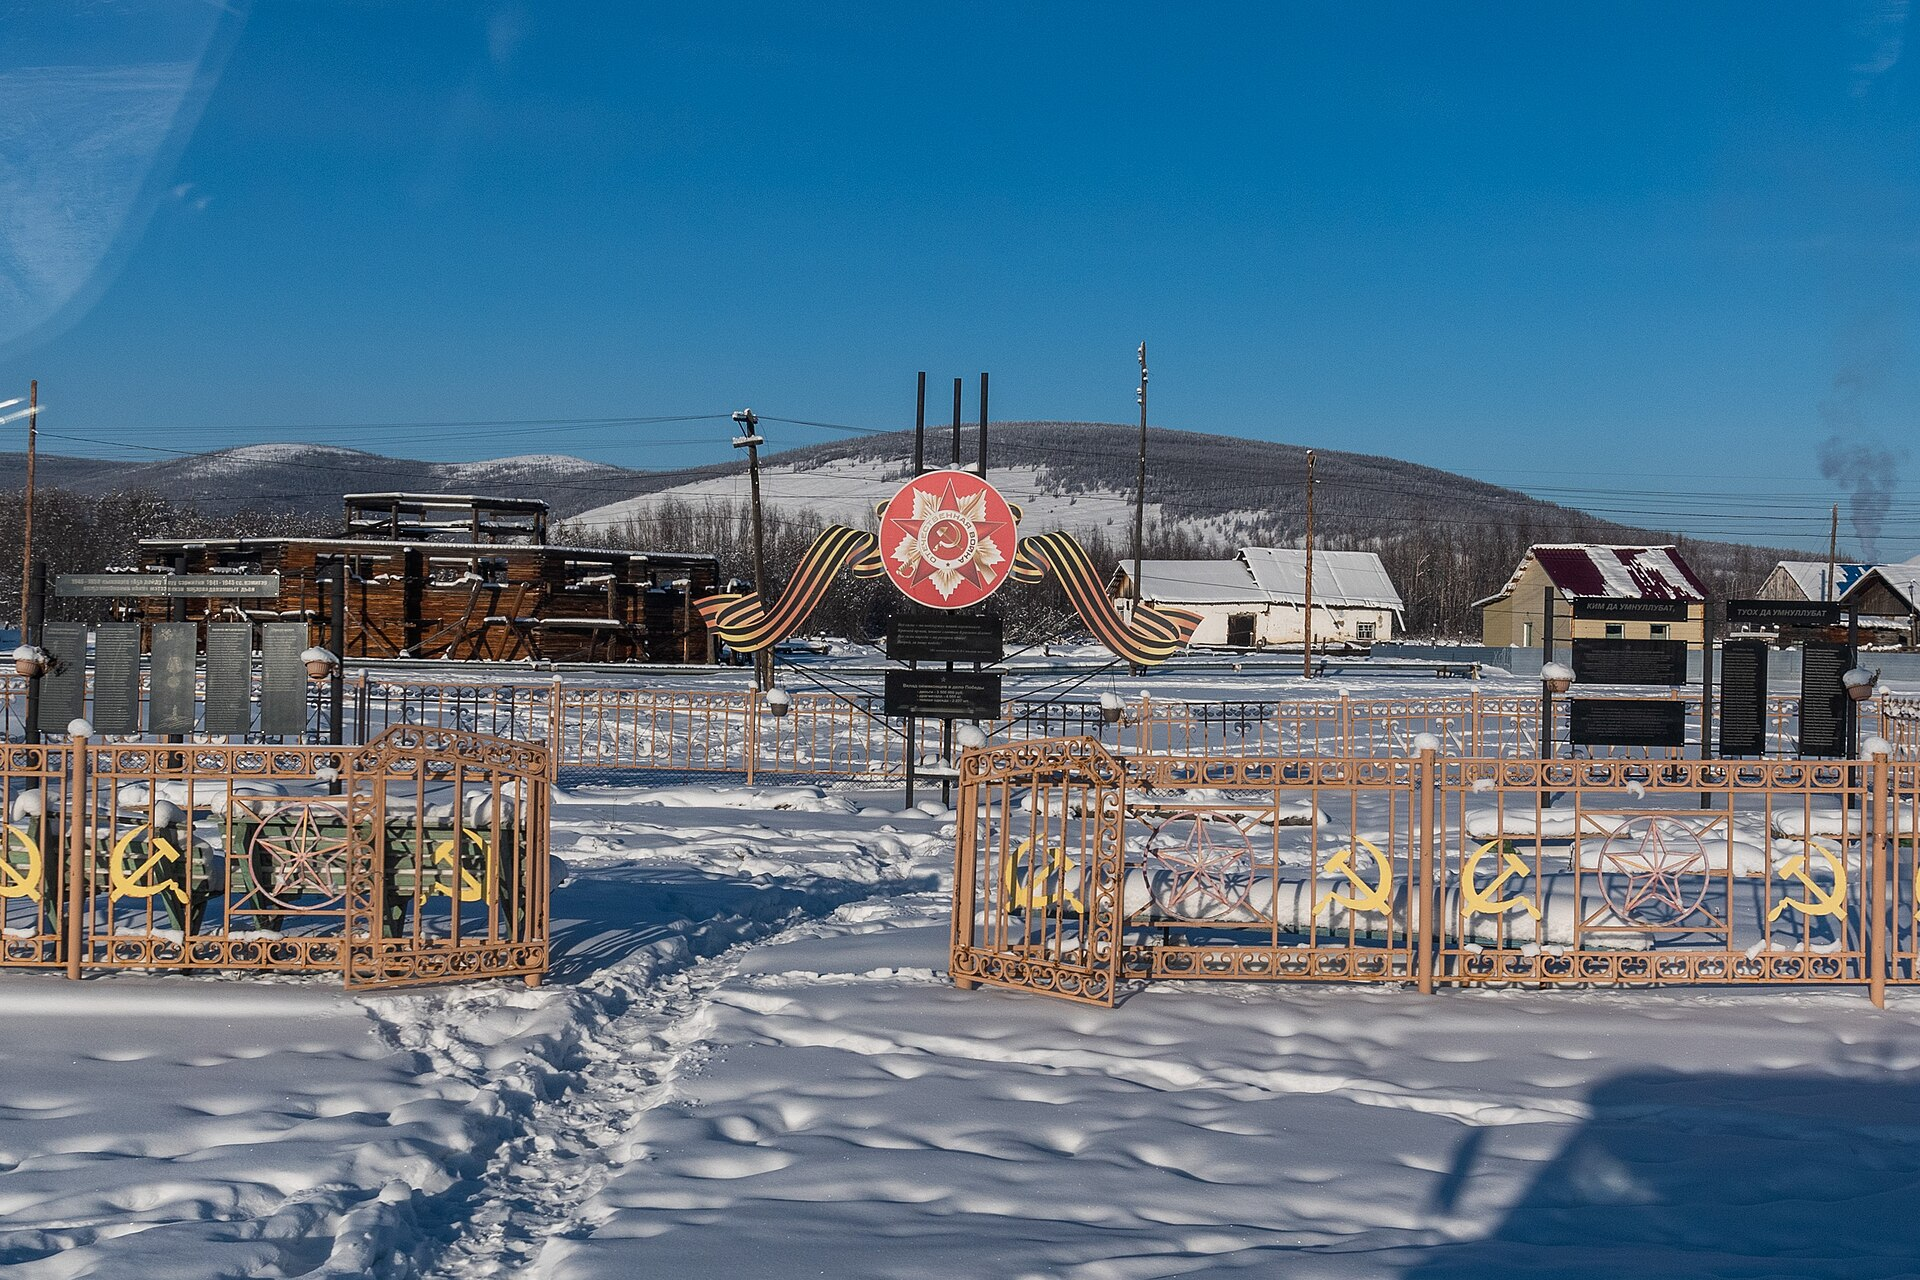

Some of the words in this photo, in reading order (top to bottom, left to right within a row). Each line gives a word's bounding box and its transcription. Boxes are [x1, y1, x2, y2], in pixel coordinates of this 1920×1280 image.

[921, 512, 972, 564] ОТЕЧЕСТВЕННАЯ
[958, 531, 976, 564] ВОЙНА
[1620, 604, 1676, 612] УМНУЛЛУБАТ,
